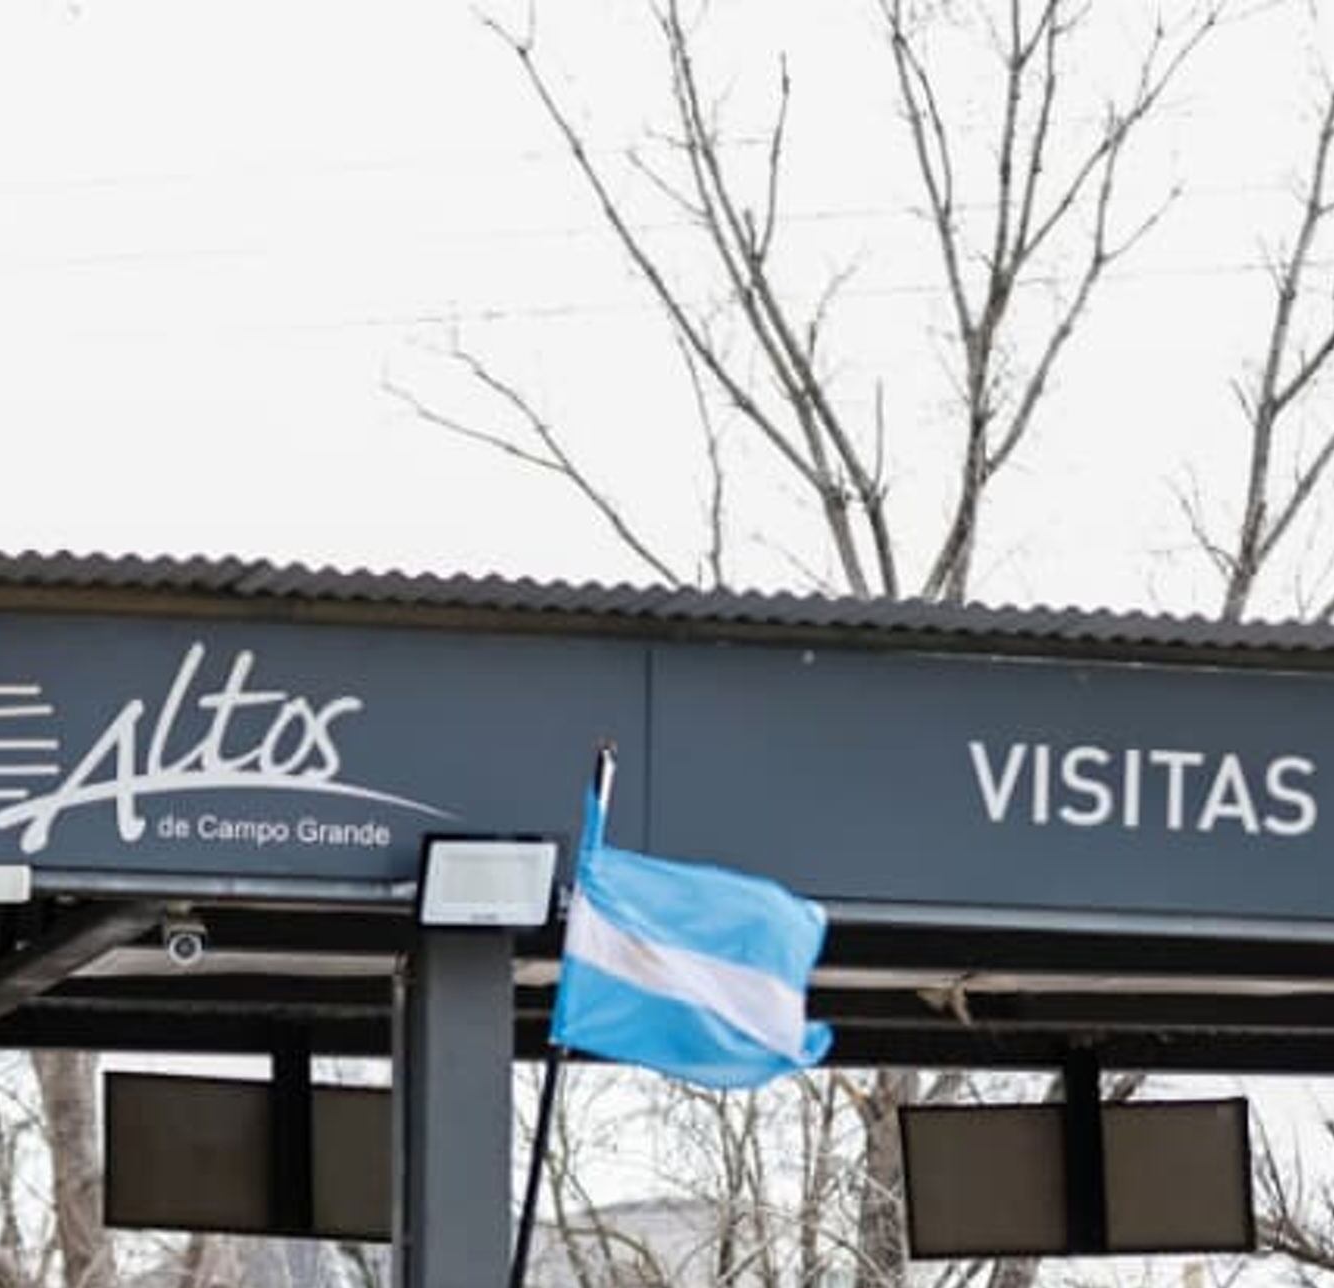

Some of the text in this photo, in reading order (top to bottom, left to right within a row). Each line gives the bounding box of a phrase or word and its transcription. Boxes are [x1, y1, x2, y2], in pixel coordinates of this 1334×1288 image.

[969, 740, 1318, 836] VISITAS
[157, 814, 391, 847] de Campo Grande
